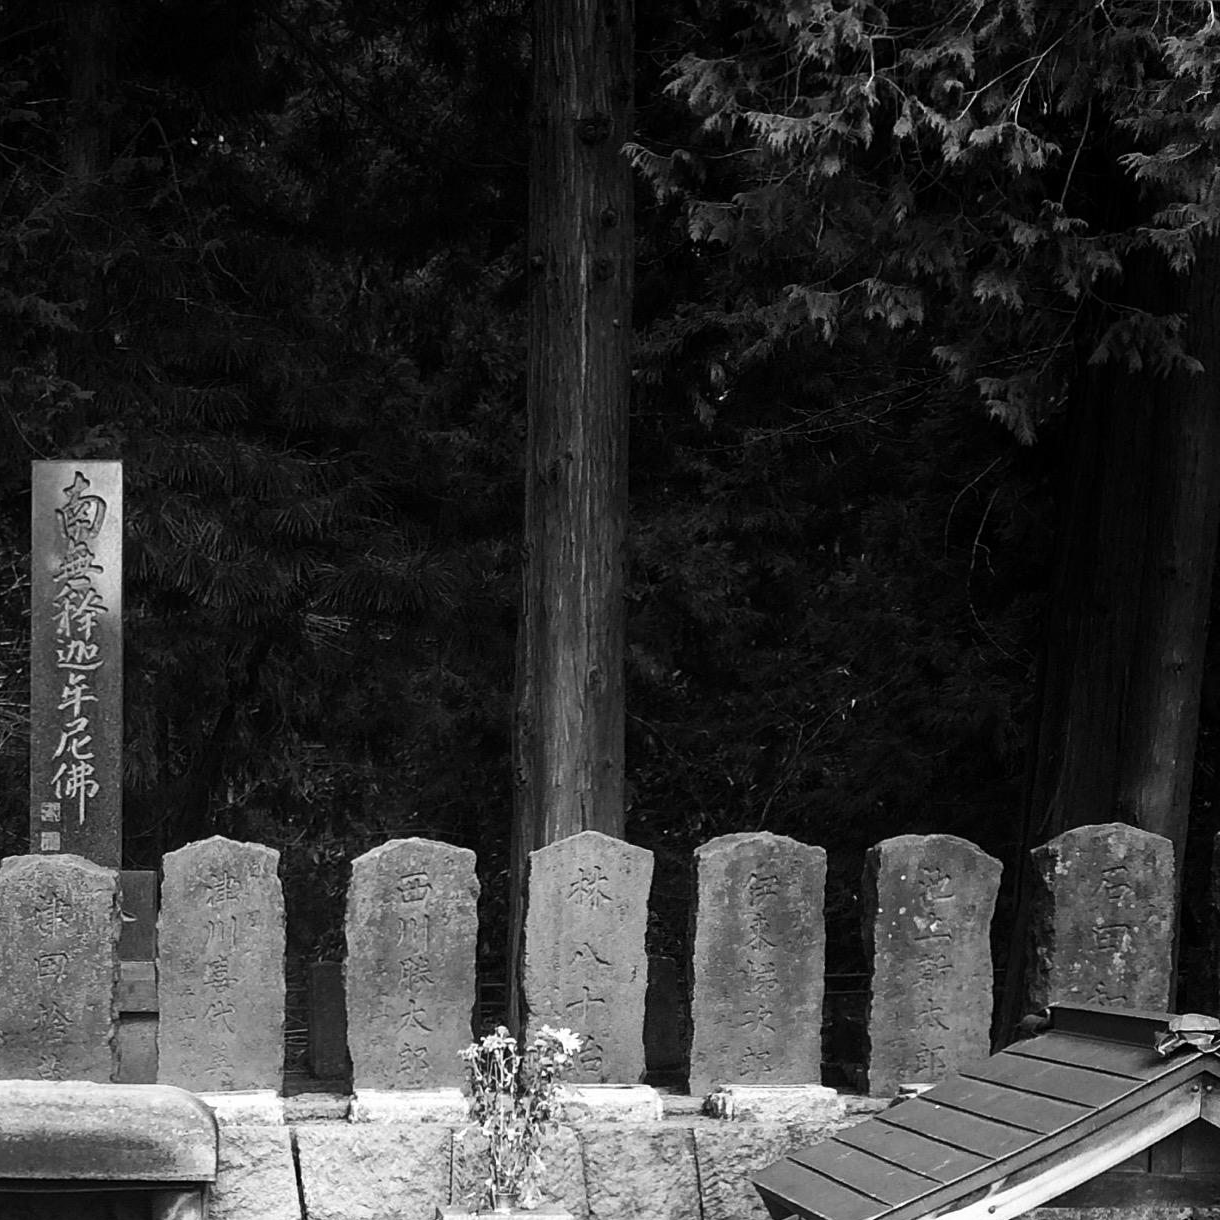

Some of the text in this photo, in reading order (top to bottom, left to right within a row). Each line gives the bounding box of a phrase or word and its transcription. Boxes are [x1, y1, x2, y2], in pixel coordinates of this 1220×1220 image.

[201, 870, 243, 1089] 津川喜代美
[393, 871, 435, 1089] 西川勝太郎
